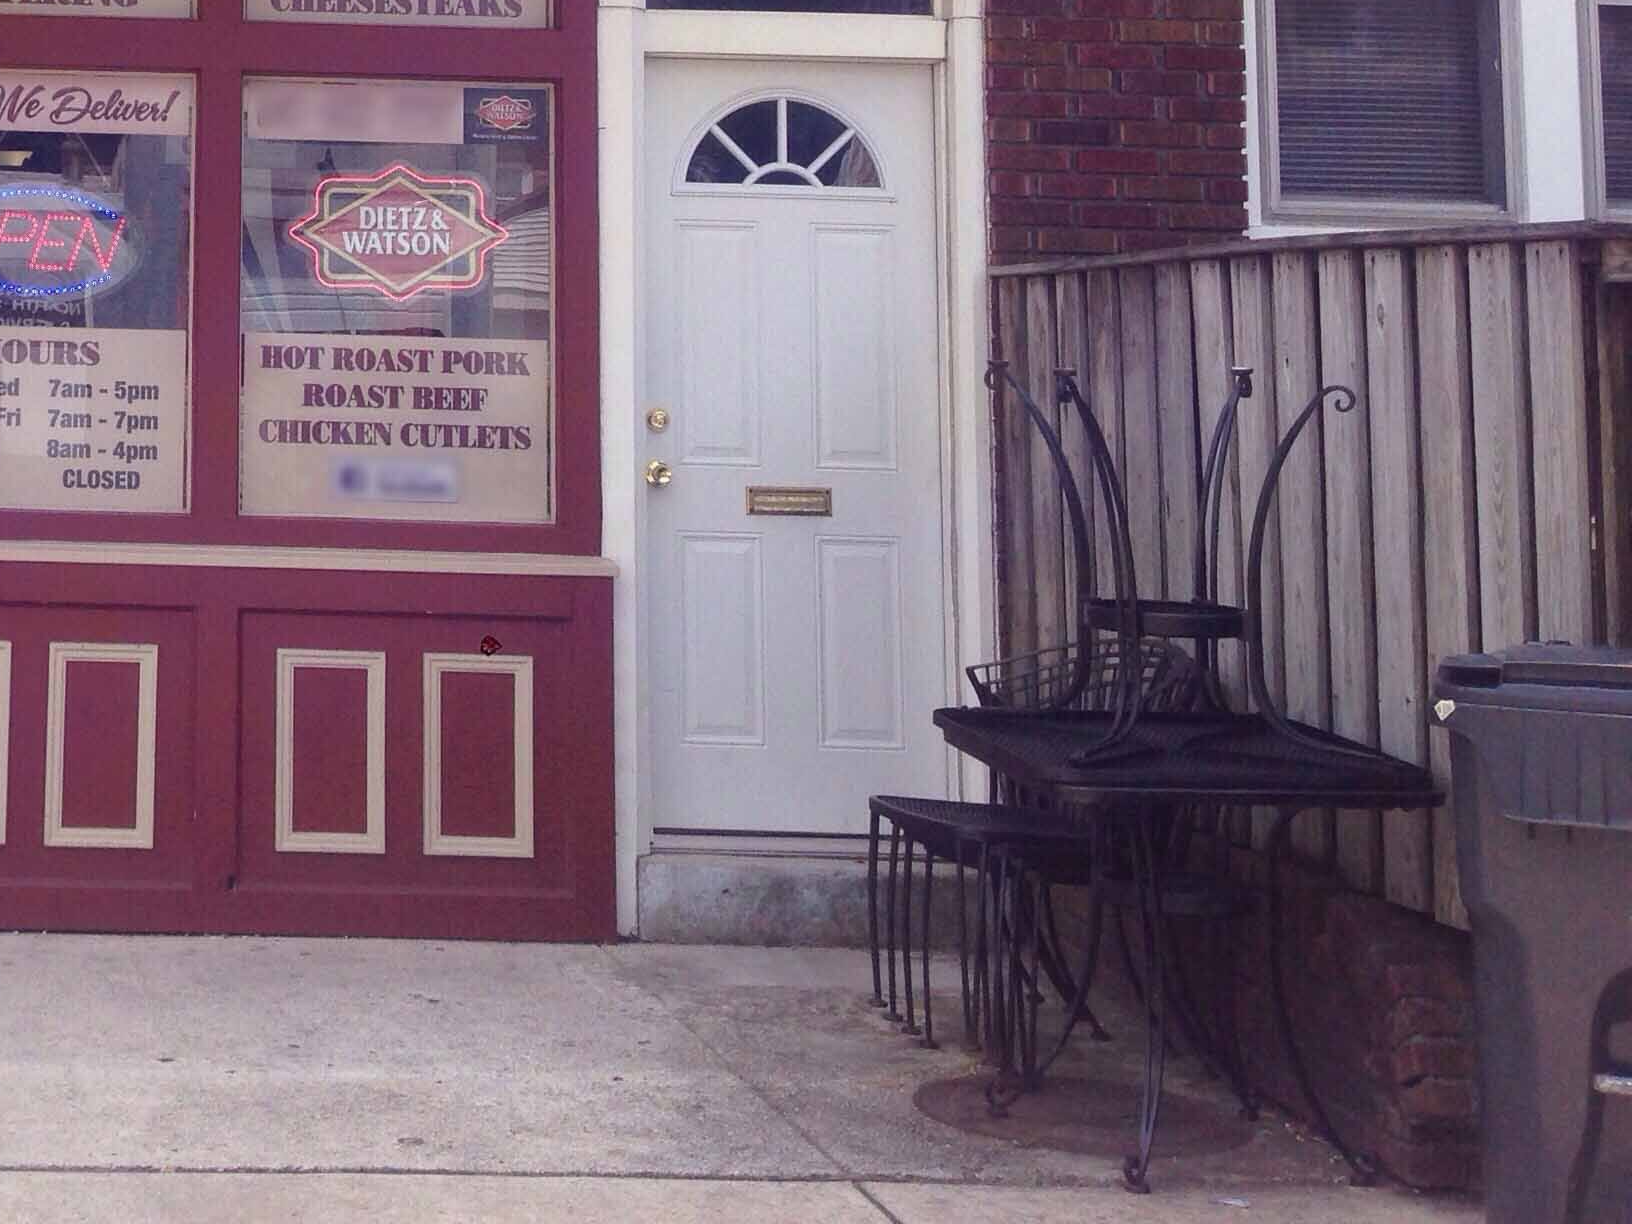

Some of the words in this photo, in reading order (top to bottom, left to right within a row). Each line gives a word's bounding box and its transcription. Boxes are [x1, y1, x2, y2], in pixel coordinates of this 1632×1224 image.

[50, 87, 180, 125] Deliver!
[359, 206, 425, 230] DIETZ
[432, 208, 449, 231] &
[342, 231, 451, 256] WATSON
[260, 344, 325, 371] HOT
[331, 346, 435, 373] ROAST
[441, 350, 531, 377] PORK
[49, 379, 92, 399] 7am
[114, 381, 159, 404] 5pm
[301, 382, 405, 409] ROAST
[413, 386, 488, 412] BEEF
[48, 409, 92, 429] 7am
[114, 411, 159, 434] 7pm
[258, 419, 393, 447] CHICKEN
[399, 423, 532, 450] CUTLETS
[47, 439, 91, 459] 8am
[113, 441, 158, 464] 4pm
[62, 469, 140, 490] CLOSED
